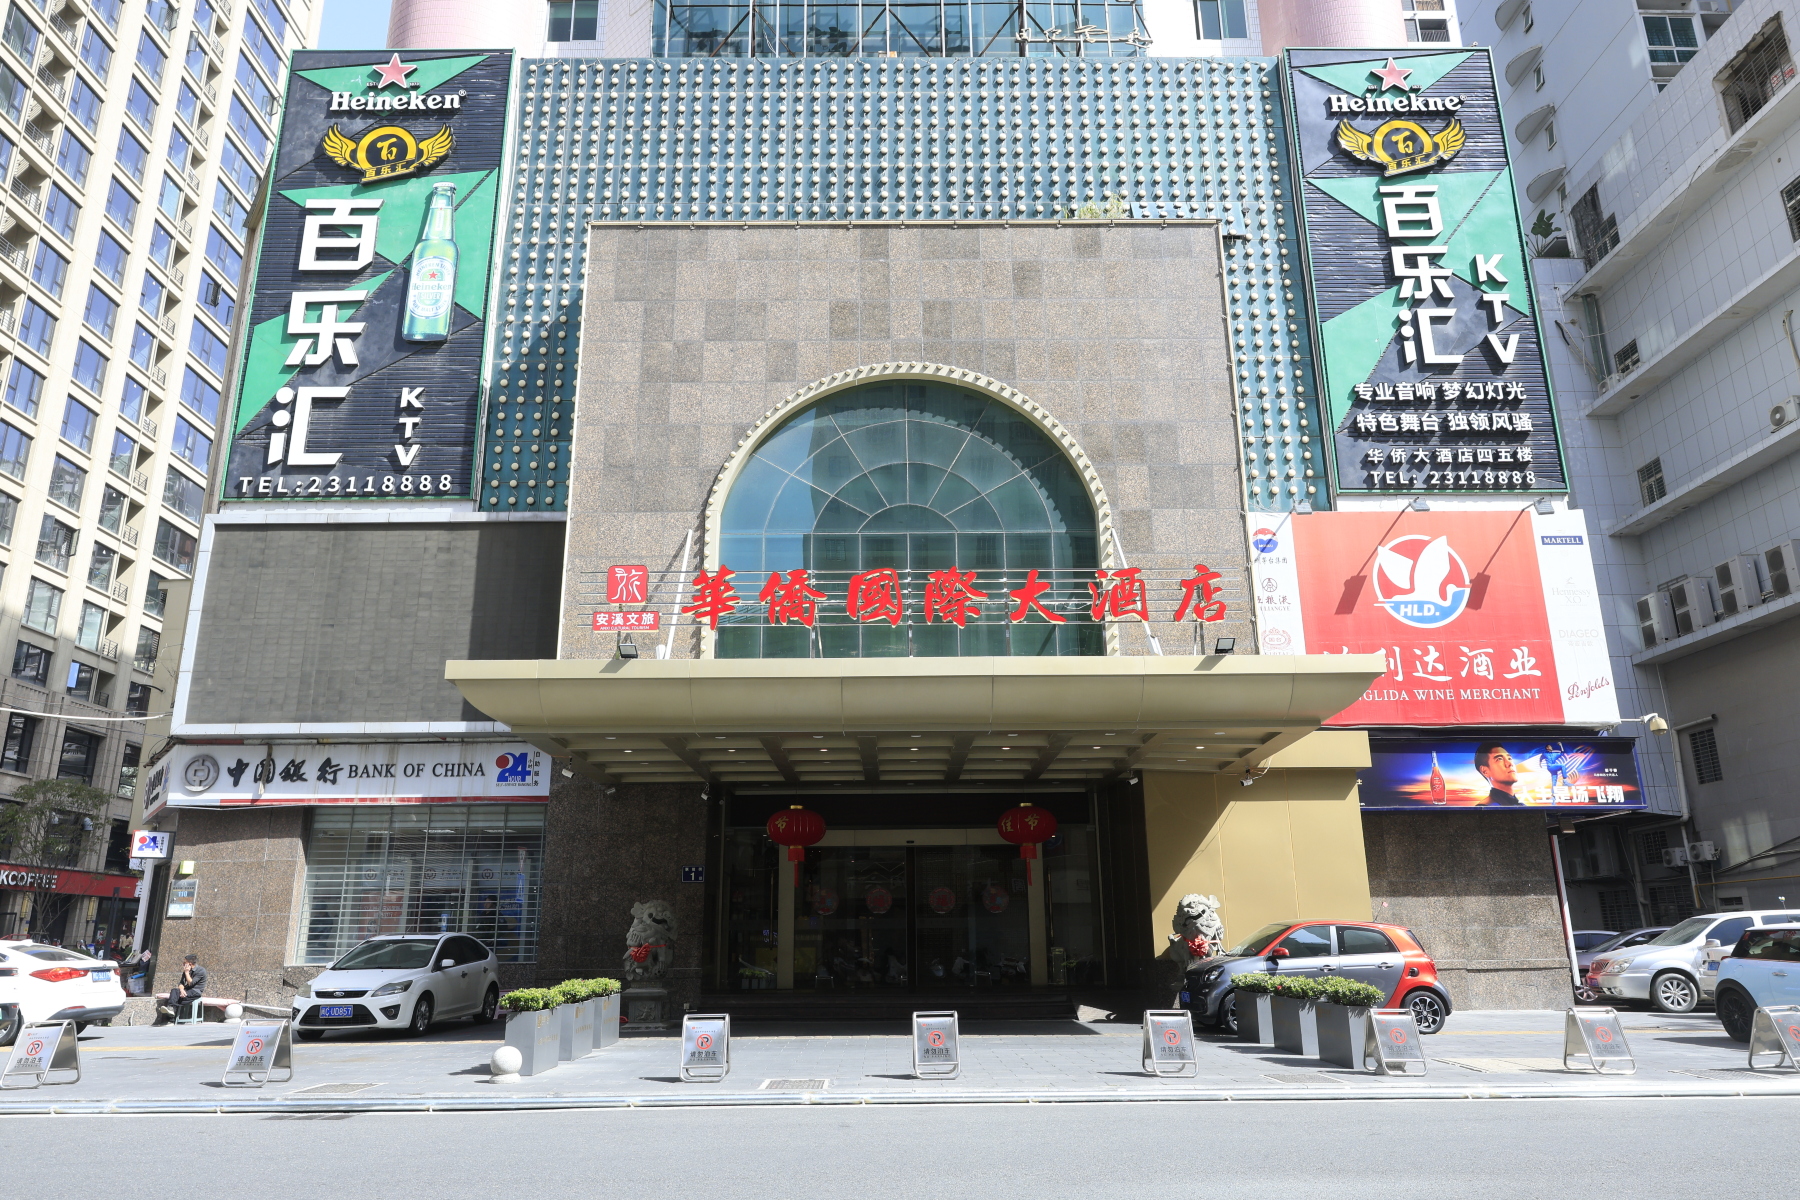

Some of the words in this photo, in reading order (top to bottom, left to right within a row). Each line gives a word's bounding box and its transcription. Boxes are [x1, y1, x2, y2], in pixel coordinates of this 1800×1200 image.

[330, 91, 460, 111] Heineken
[1328, 93, 1462, 112] Heinekne
[365, 161, 408, 178] 百乐汇
[1387, 155, 1426, 171] 百乐汇
[1379, 184, 1465, 364] 百乐汇
[1475, 253, 1520, 364] KTV
[267, 198, 386, 466] 百乐汇
[1354, 382, 1436, 400] 专业音响
[1442, 382, 1527, 400] 梦幻灯光
[394, 387, 426, 467] KTV
[1356, 413, 1439, 432] 特色舞台
[1448, 412, 1534, 432] 独领风骚
[1367, 447, 1534, 463] 华侨大酒店四五楼
[1429, 471, 1536, 484] 23118888
[596, 612, 655, 626] 安溪文旅
[1558, 629, 1599, 639] DIAGEO
[1322, 645, 1542, 682] 利达酒业
[1358, 689, 1410, 701] GLIDA
[1413, 689, 1455, 700] WINE
[1460, 688, 1541, 700] MERCHANT
[347, 763, 396, 779] BANK
[403, 763, 425, 777] OF
[432, 762, 486, 777] CHINA
[1514, 785, 1625, 803] 人生是场飞翔
